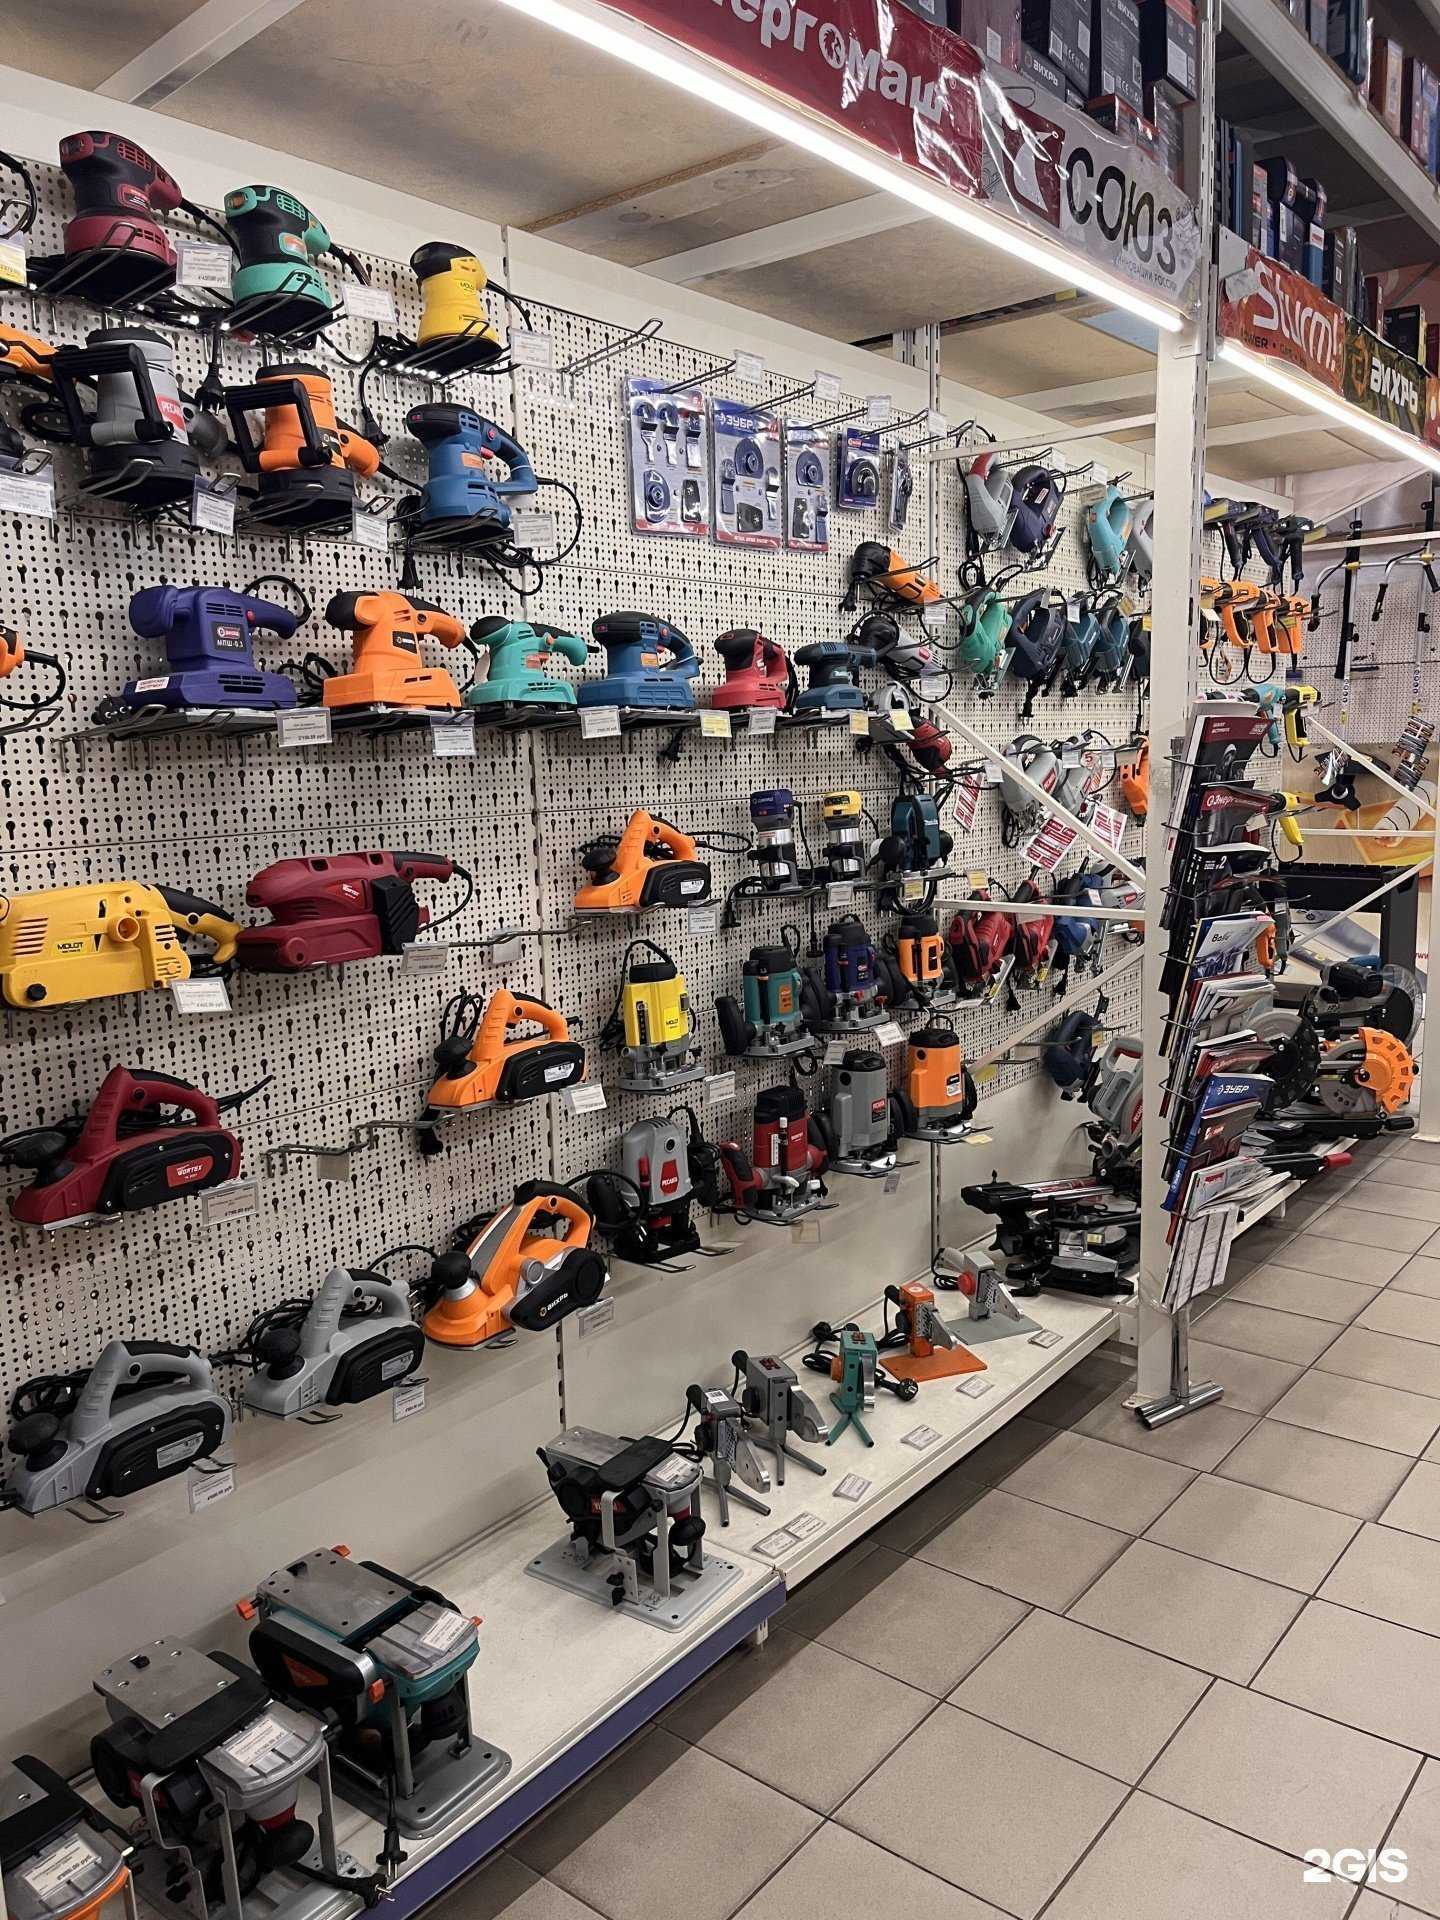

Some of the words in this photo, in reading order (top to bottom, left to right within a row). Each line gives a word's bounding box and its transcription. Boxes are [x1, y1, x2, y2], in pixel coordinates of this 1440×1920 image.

[1065, 146, 1176, 275] СОЮЗ
[1252, 259, 1339, 373] Sturm!
[726, 414, 754, 430] ЗУБР
[1223, 1085, 1250, 1094] ЗУБР
